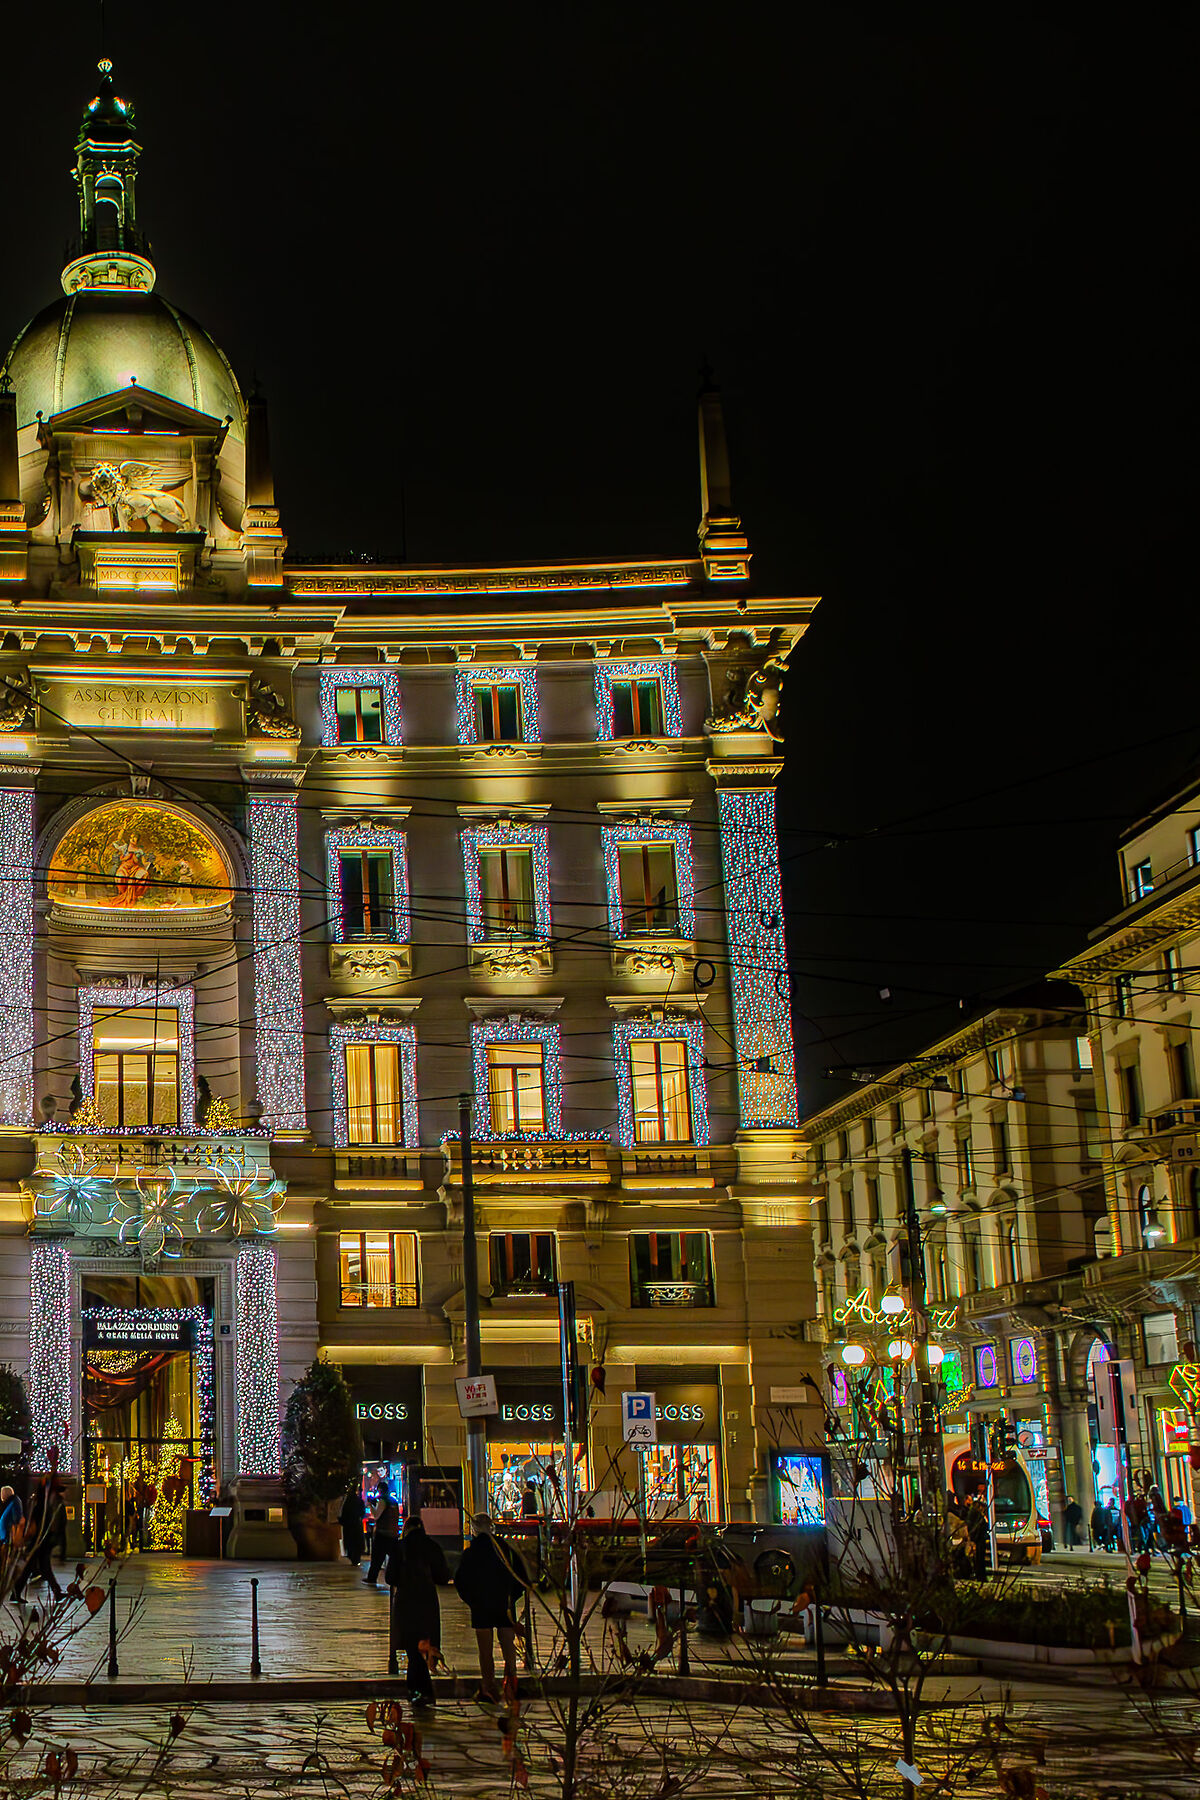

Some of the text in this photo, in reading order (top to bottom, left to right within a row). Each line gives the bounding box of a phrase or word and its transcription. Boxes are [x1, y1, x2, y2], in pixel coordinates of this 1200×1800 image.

[73, 688, 209, 704] ASSICVRAZIONI
[97, 707, 184, 722] GENERALI
[97, 1322, 179, 1332] PALAZZO CORDUSIO
[155, 1332, 180, 1340] HOTEL
[356, 1403, 408, 1420] BOSS
[502, 1403, 555, 1421] BOSS
[632, 1399, 646, 1416] P
